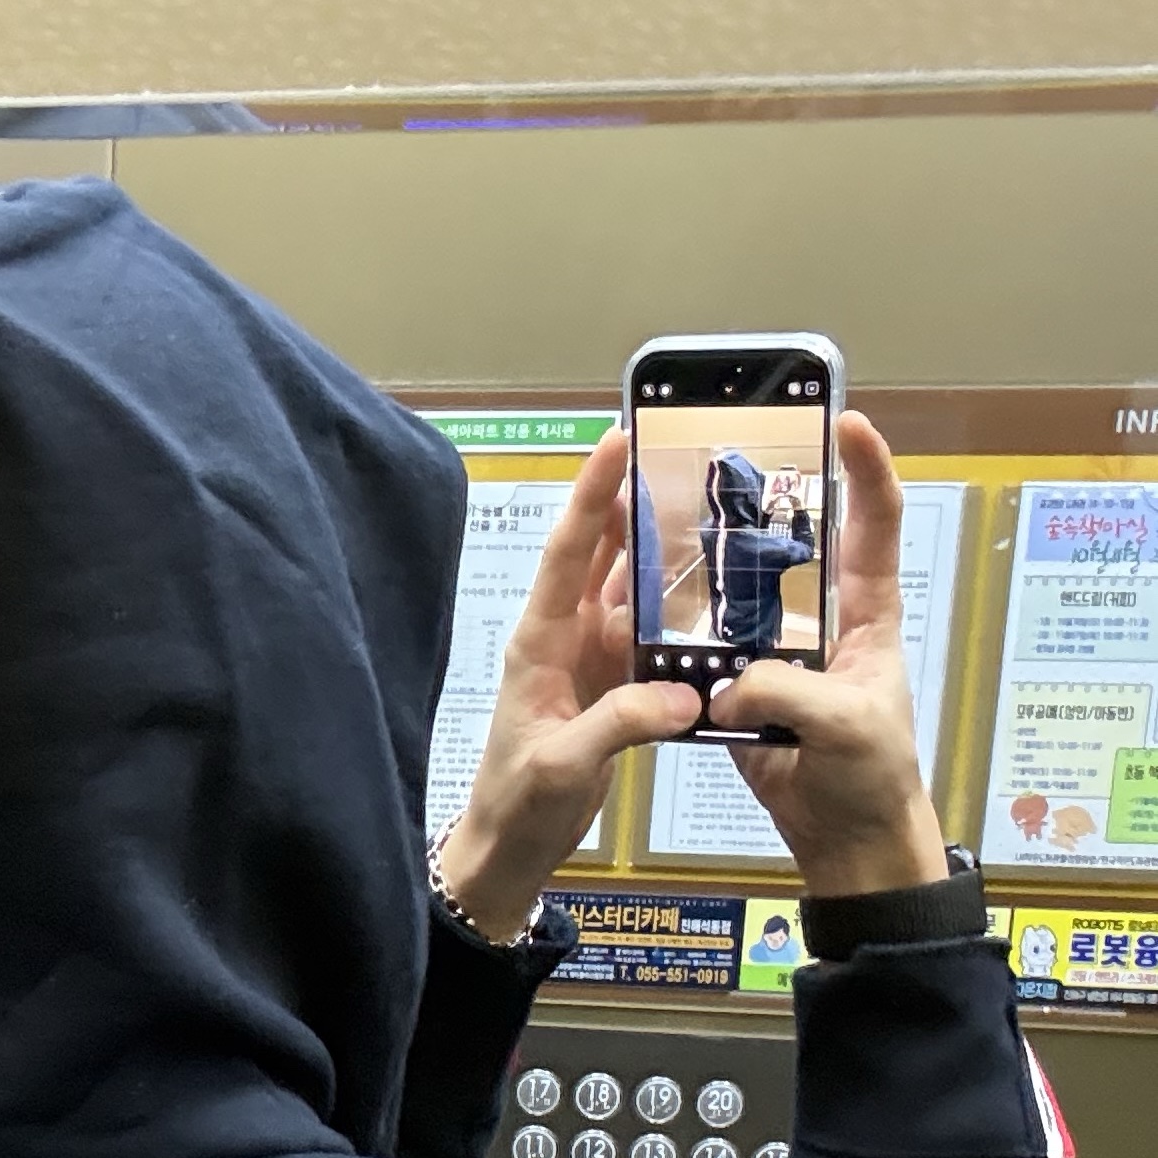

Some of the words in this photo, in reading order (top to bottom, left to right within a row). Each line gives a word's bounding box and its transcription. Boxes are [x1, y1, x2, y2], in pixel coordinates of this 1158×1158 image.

[535, 423, 576, 438] 게시판
[528, 1078, 551, 1102] 17
[588, 1081, 610, 1105] 18
[648, 1085, 672, 1109] 19
[708, 1090, 733, 1111] 20
